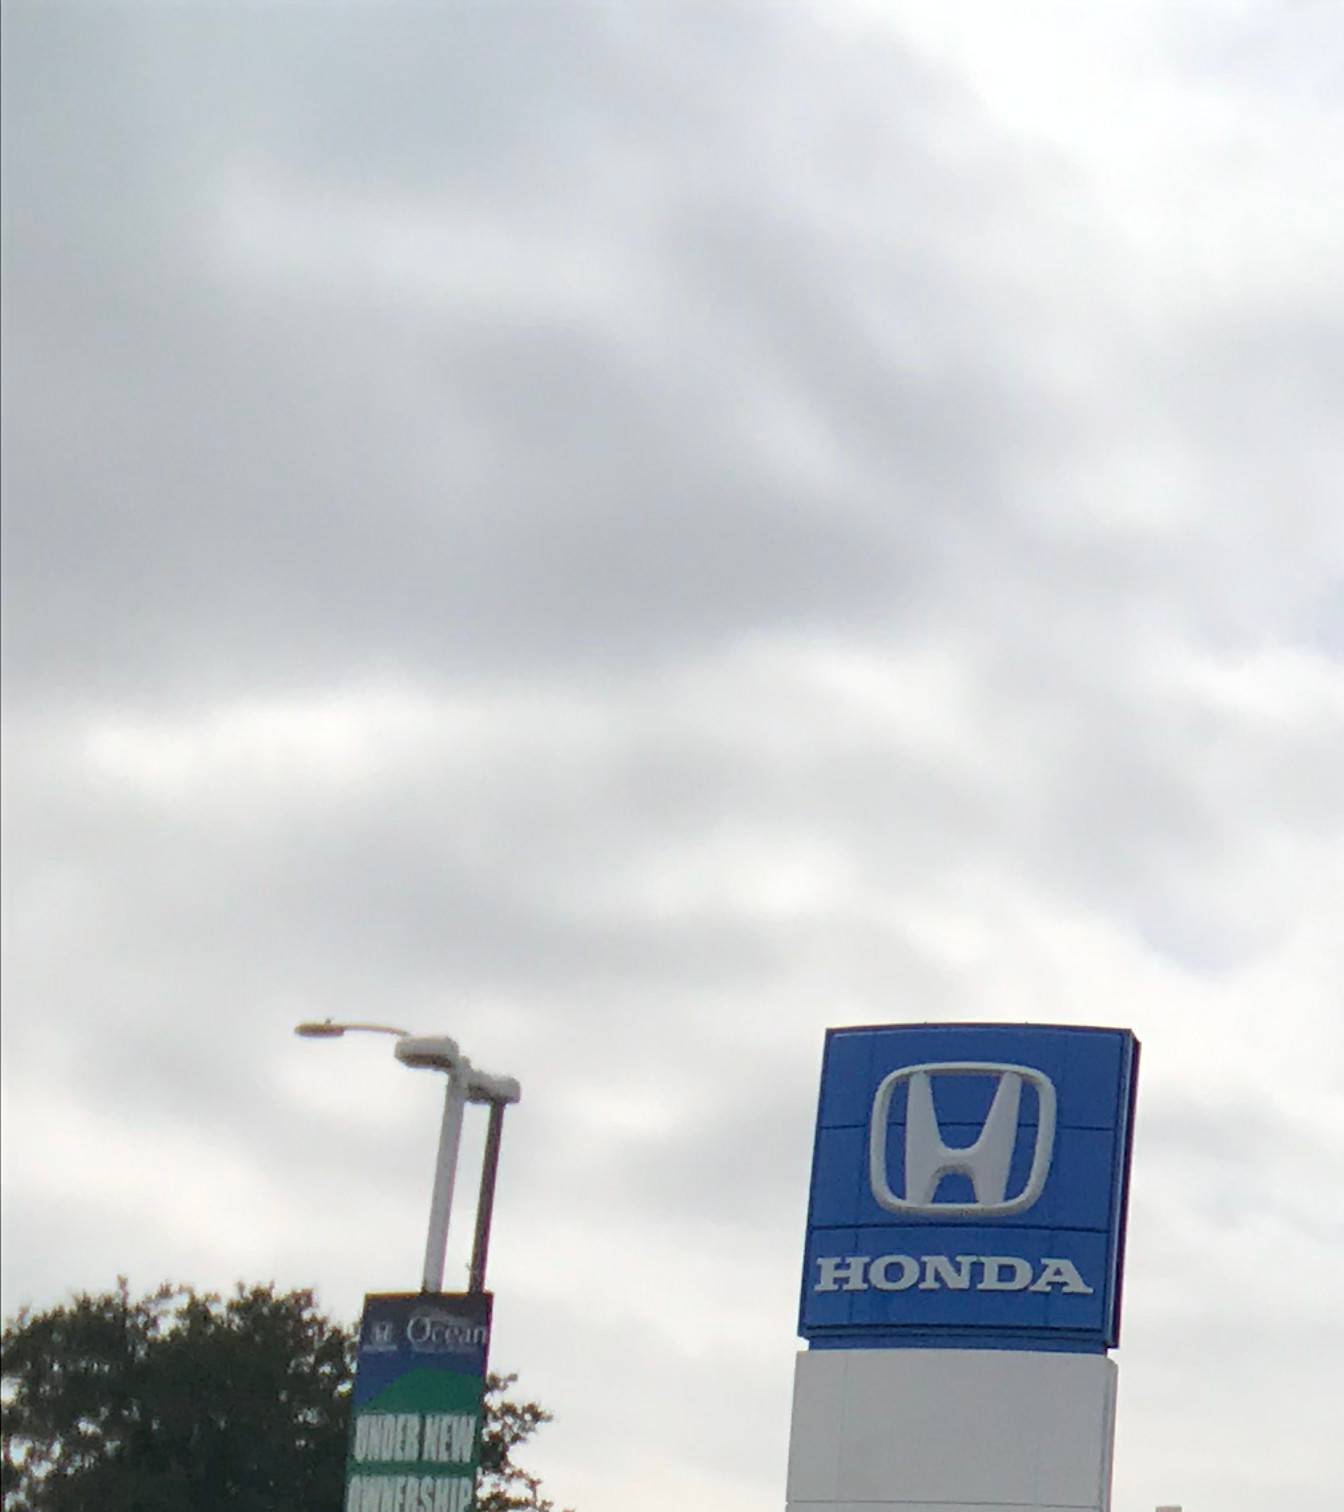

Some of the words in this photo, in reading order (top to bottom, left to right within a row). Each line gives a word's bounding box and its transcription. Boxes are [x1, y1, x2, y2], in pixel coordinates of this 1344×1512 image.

[813, 1255, 1094, 1294] HONDA
[407, 1316, 487, 1345] Ocean
[354, 1413, 420, 1463] UNDER
[422, 1414, 478, 1463] NEW
